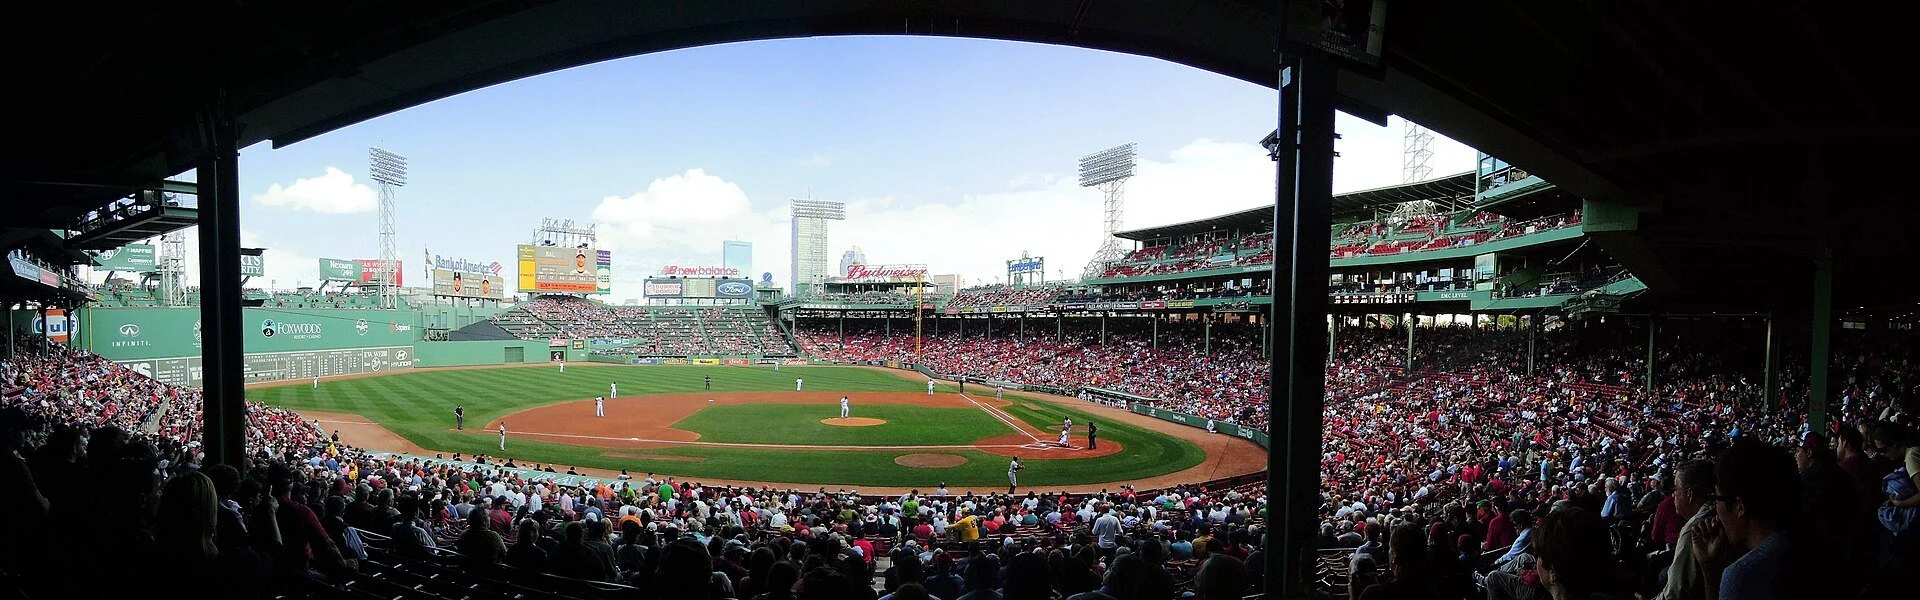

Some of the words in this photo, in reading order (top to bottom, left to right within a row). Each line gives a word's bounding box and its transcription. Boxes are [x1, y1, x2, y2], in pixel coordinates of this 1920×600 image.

[435, 254, 454, 270] Bank
[455, 258, 463, 271] of
[464, 259, 489, 273] America
[848, 264, 928, 280] Budweiser
[724, 284, 745, 293] Ford
[278, 322, 322, 335] FOXWOODS
[395, 323, 411, 333] Sapient
[391, 360, 412, 368] HYUNDAI
